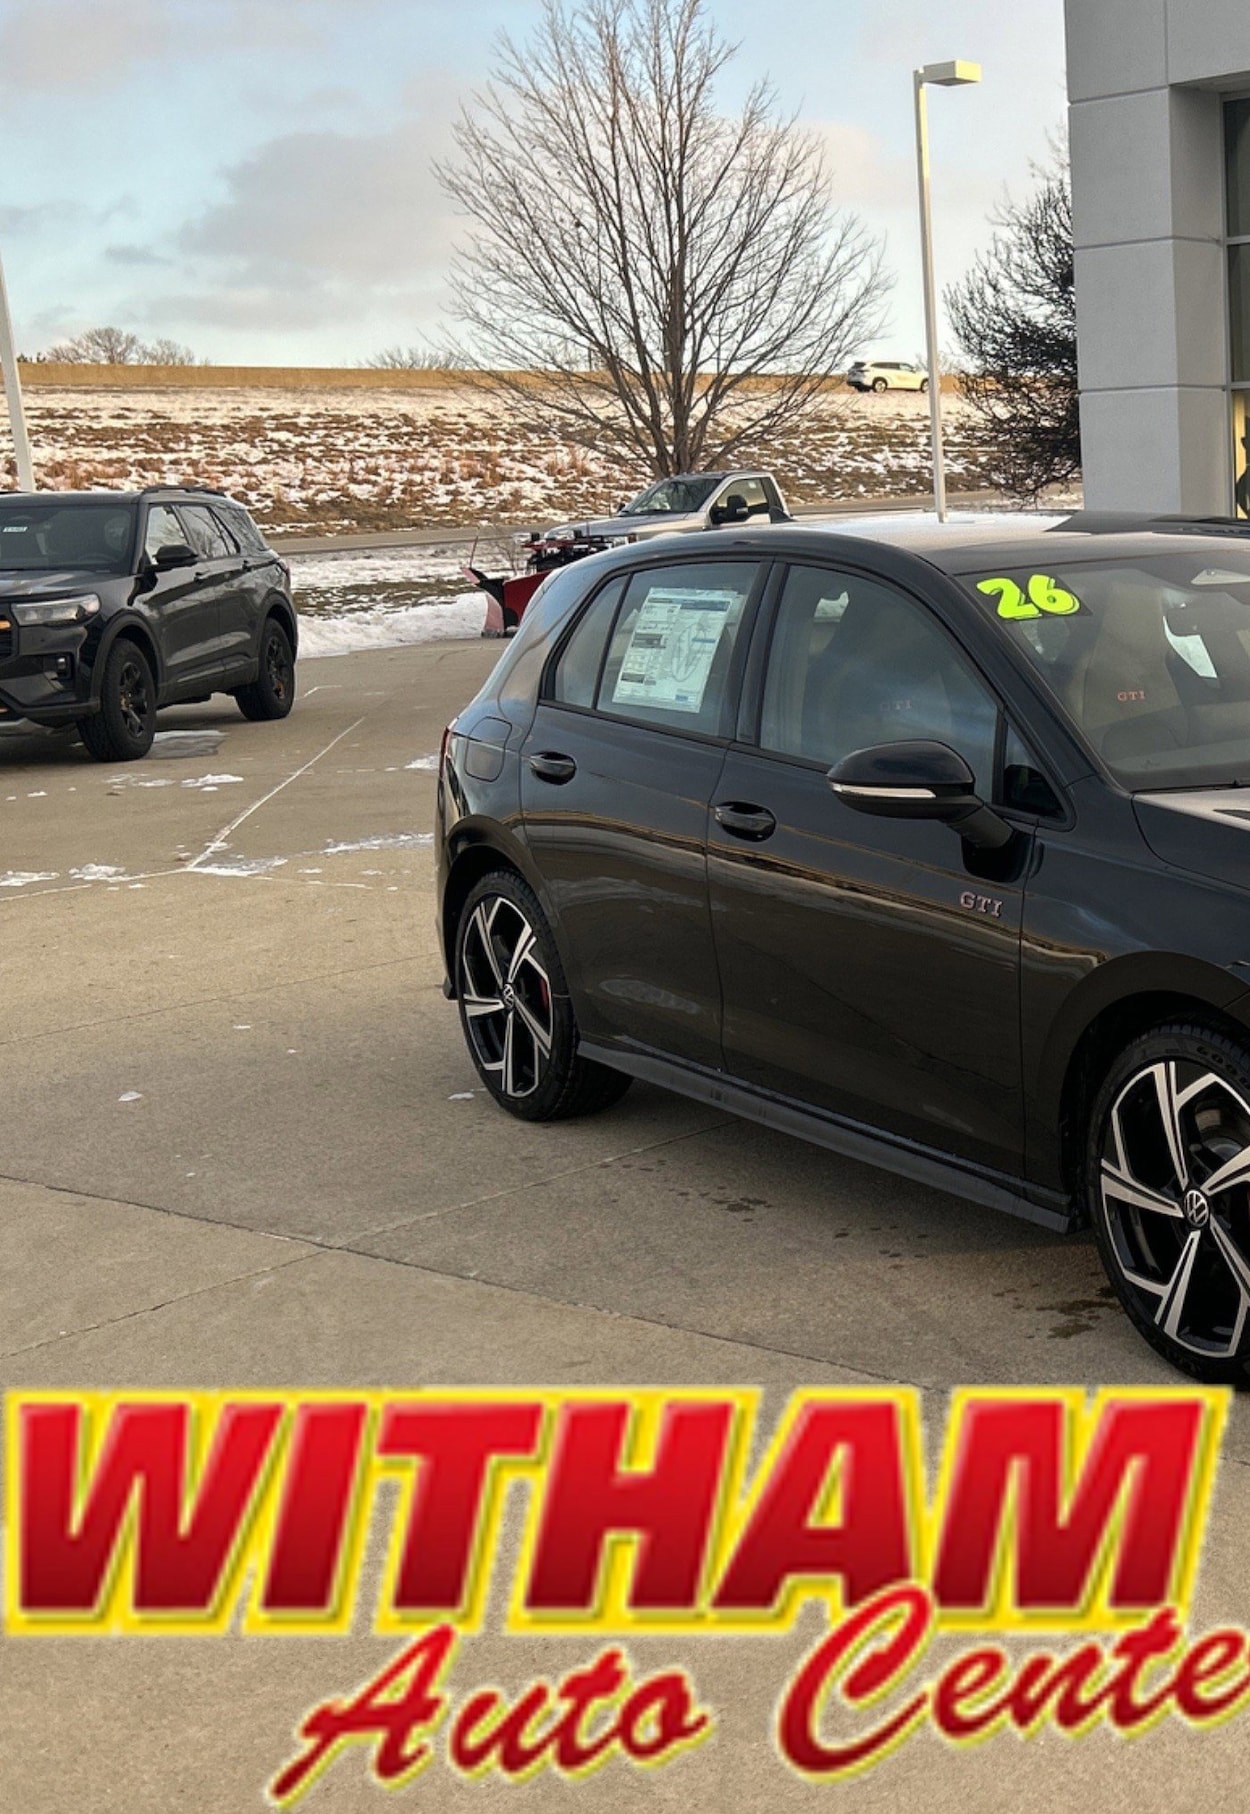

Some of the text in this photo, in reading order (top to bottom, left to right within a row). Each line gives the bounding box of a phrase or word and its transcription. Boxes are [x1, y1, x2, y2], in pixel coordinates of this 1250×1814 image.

[977, 574, 1081, 620] 26
[1117, 689, 1146, 702] GTI
[960, 891, 1004, 918] GTI
